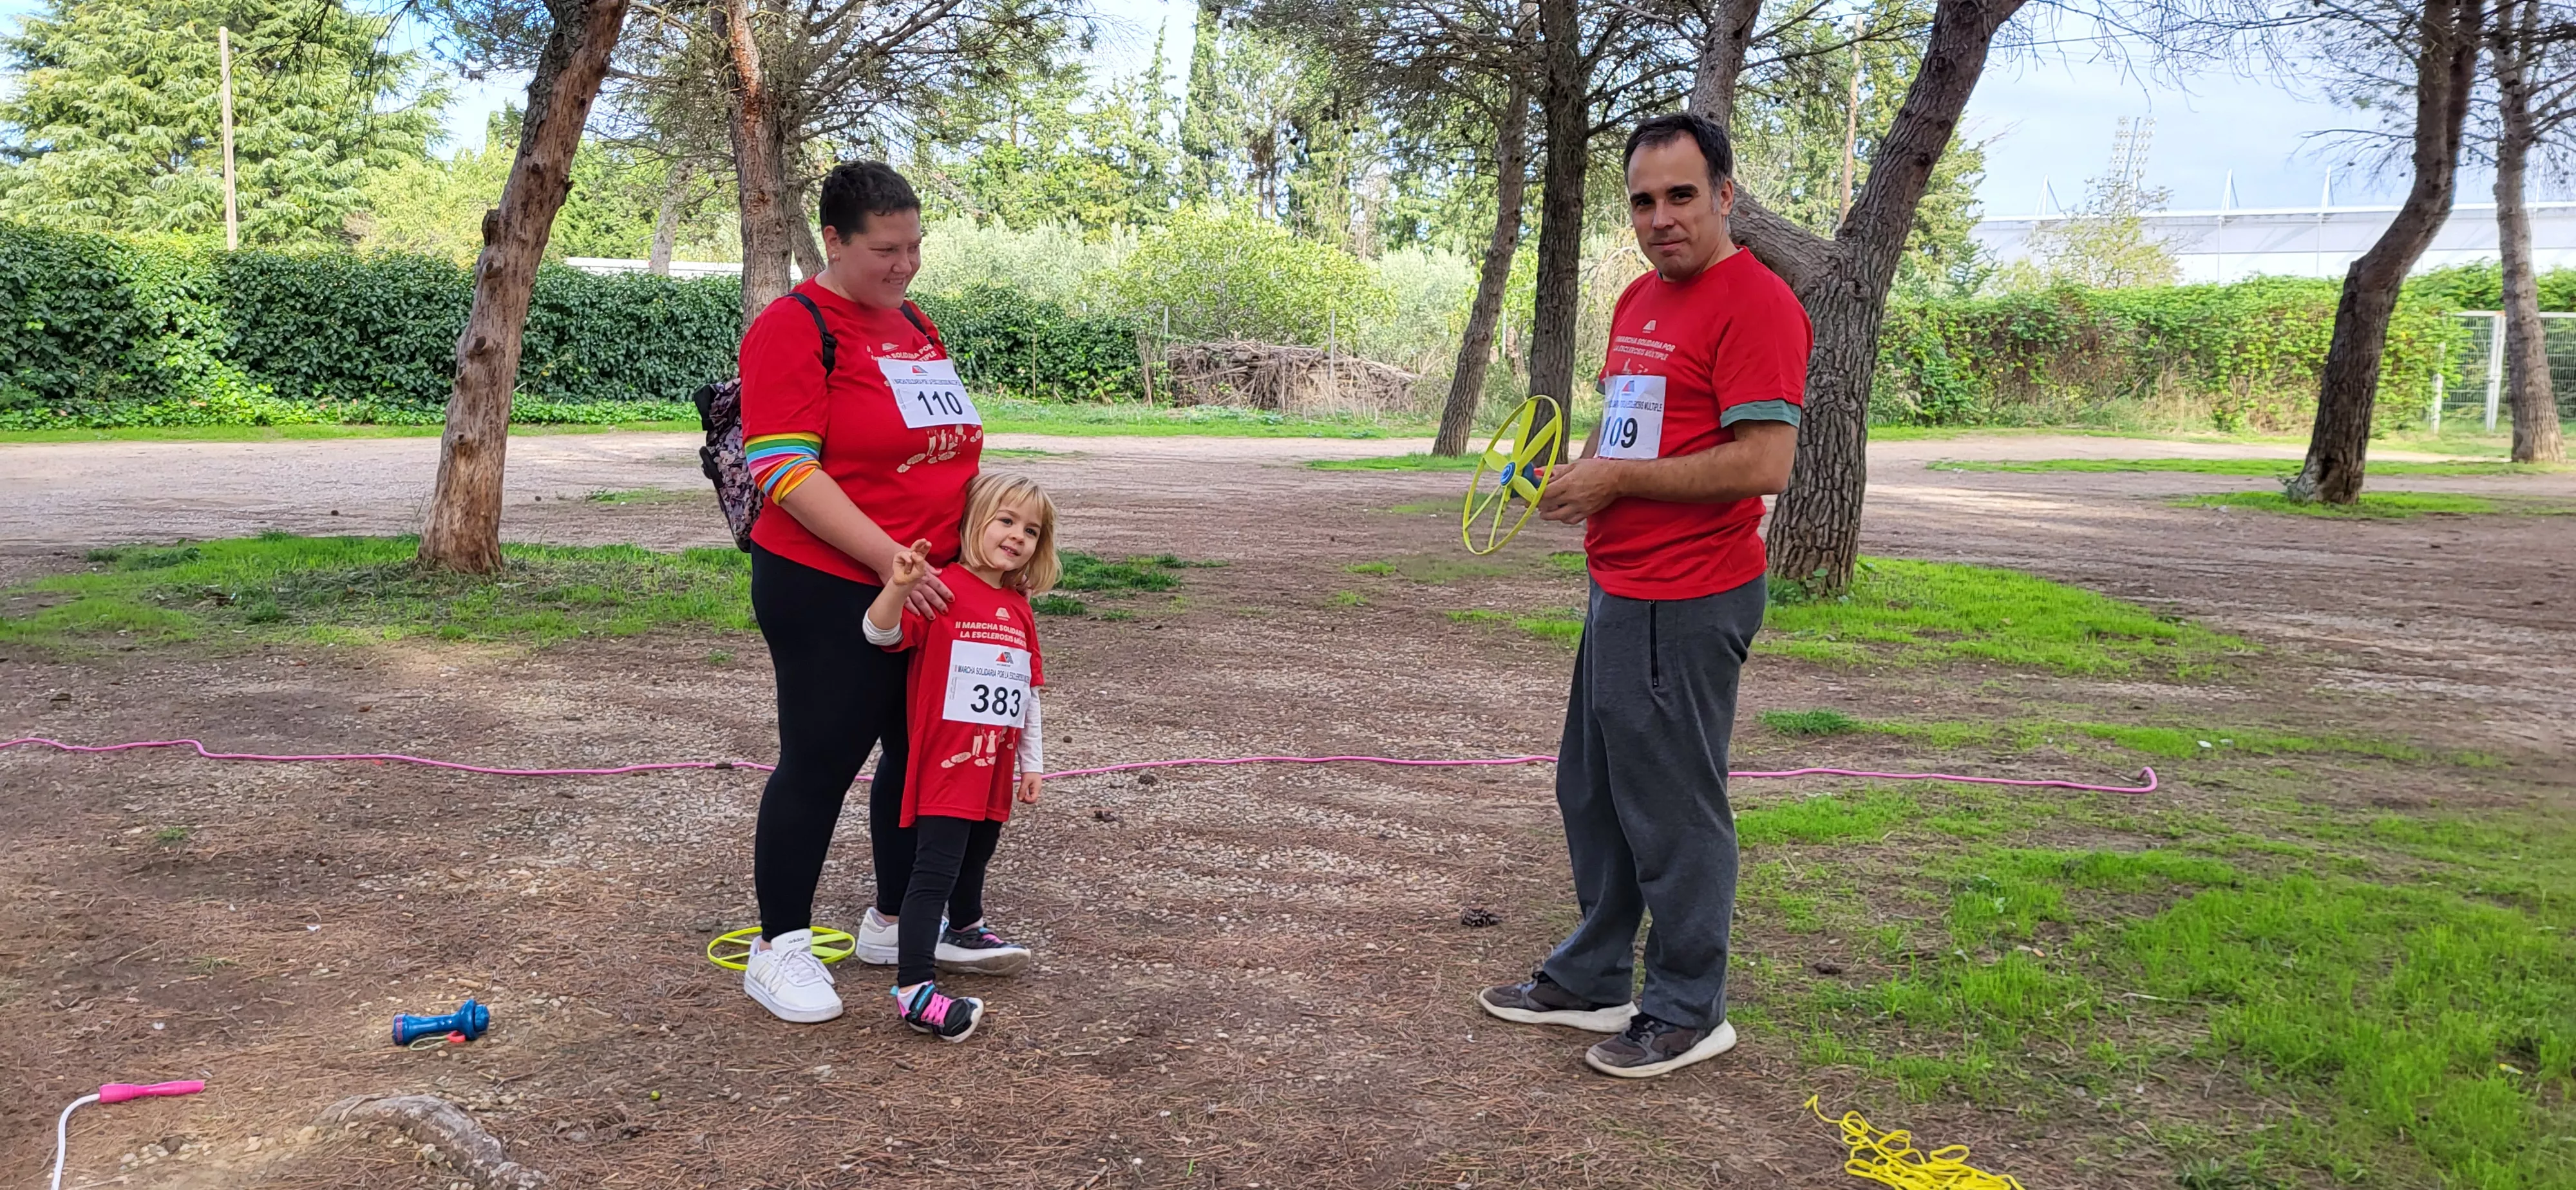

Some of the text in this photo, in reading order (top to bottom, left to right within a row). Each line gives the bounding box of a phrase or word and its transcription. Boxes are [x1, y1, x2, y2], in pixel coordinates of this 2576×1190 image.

[918, 343, 934, 354] POR
[1662, 343, 1676, 352] POR
[917, 390, 963, 415] 110
[962, 621, 998, 631] MARCHA
[971, 631, 1014, 643] ESCLEROSIS
[958, 665, 976, 675] MARCHA
[976, 667, 997, 677] SOLIDARIA
[971, 684, 1021, 717] 383
